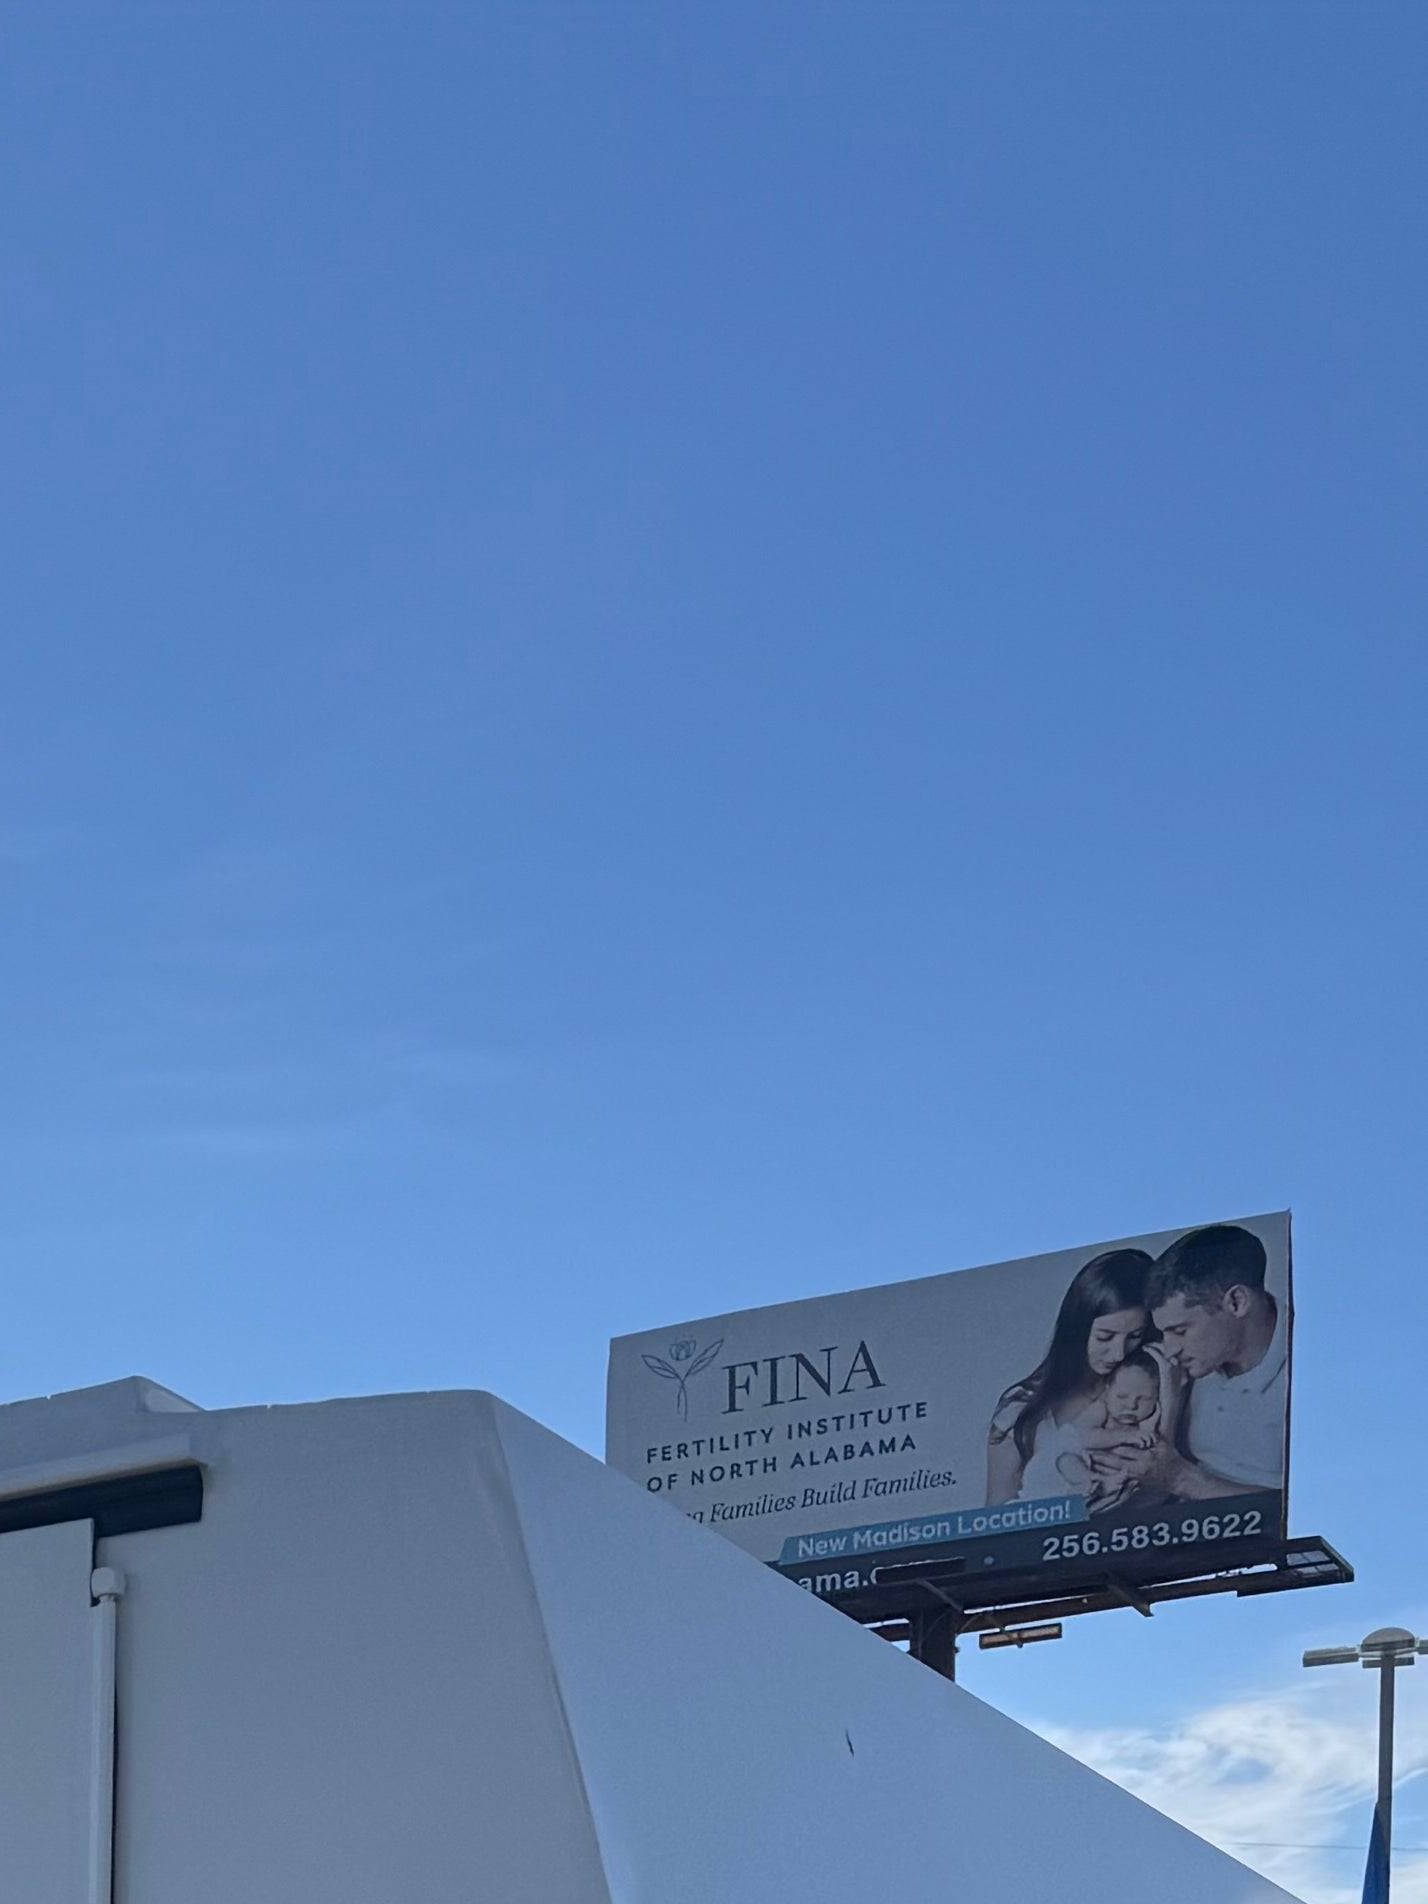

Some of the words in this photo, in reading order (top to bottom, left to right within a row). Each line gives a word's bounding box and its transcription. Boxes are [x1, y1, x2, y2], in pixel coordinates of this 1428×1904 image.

[721, 1340, 887, 1414] FINA
[646, 1427, 774, 1464] FERTILITY
[787, 1402, 928, 1440] INSTITUTE
[646, 1474, 679, 1493] OF
[691, 1456, 777, 1486] NORTH
[790, 1434, 916, 1469] ALABAMA
[710, 1494, 796, 1523] Families
[801, 1480, 857, 1508] Build
[861, 1468, 957, 1499] Families.
[798, 1537, 847, 1557] New
[852, 1519, 951, 1550] Madison
[957, 1502, 1072, 1534] Location!
[1043, 1510, 1263, 1561] 256.583.9622
